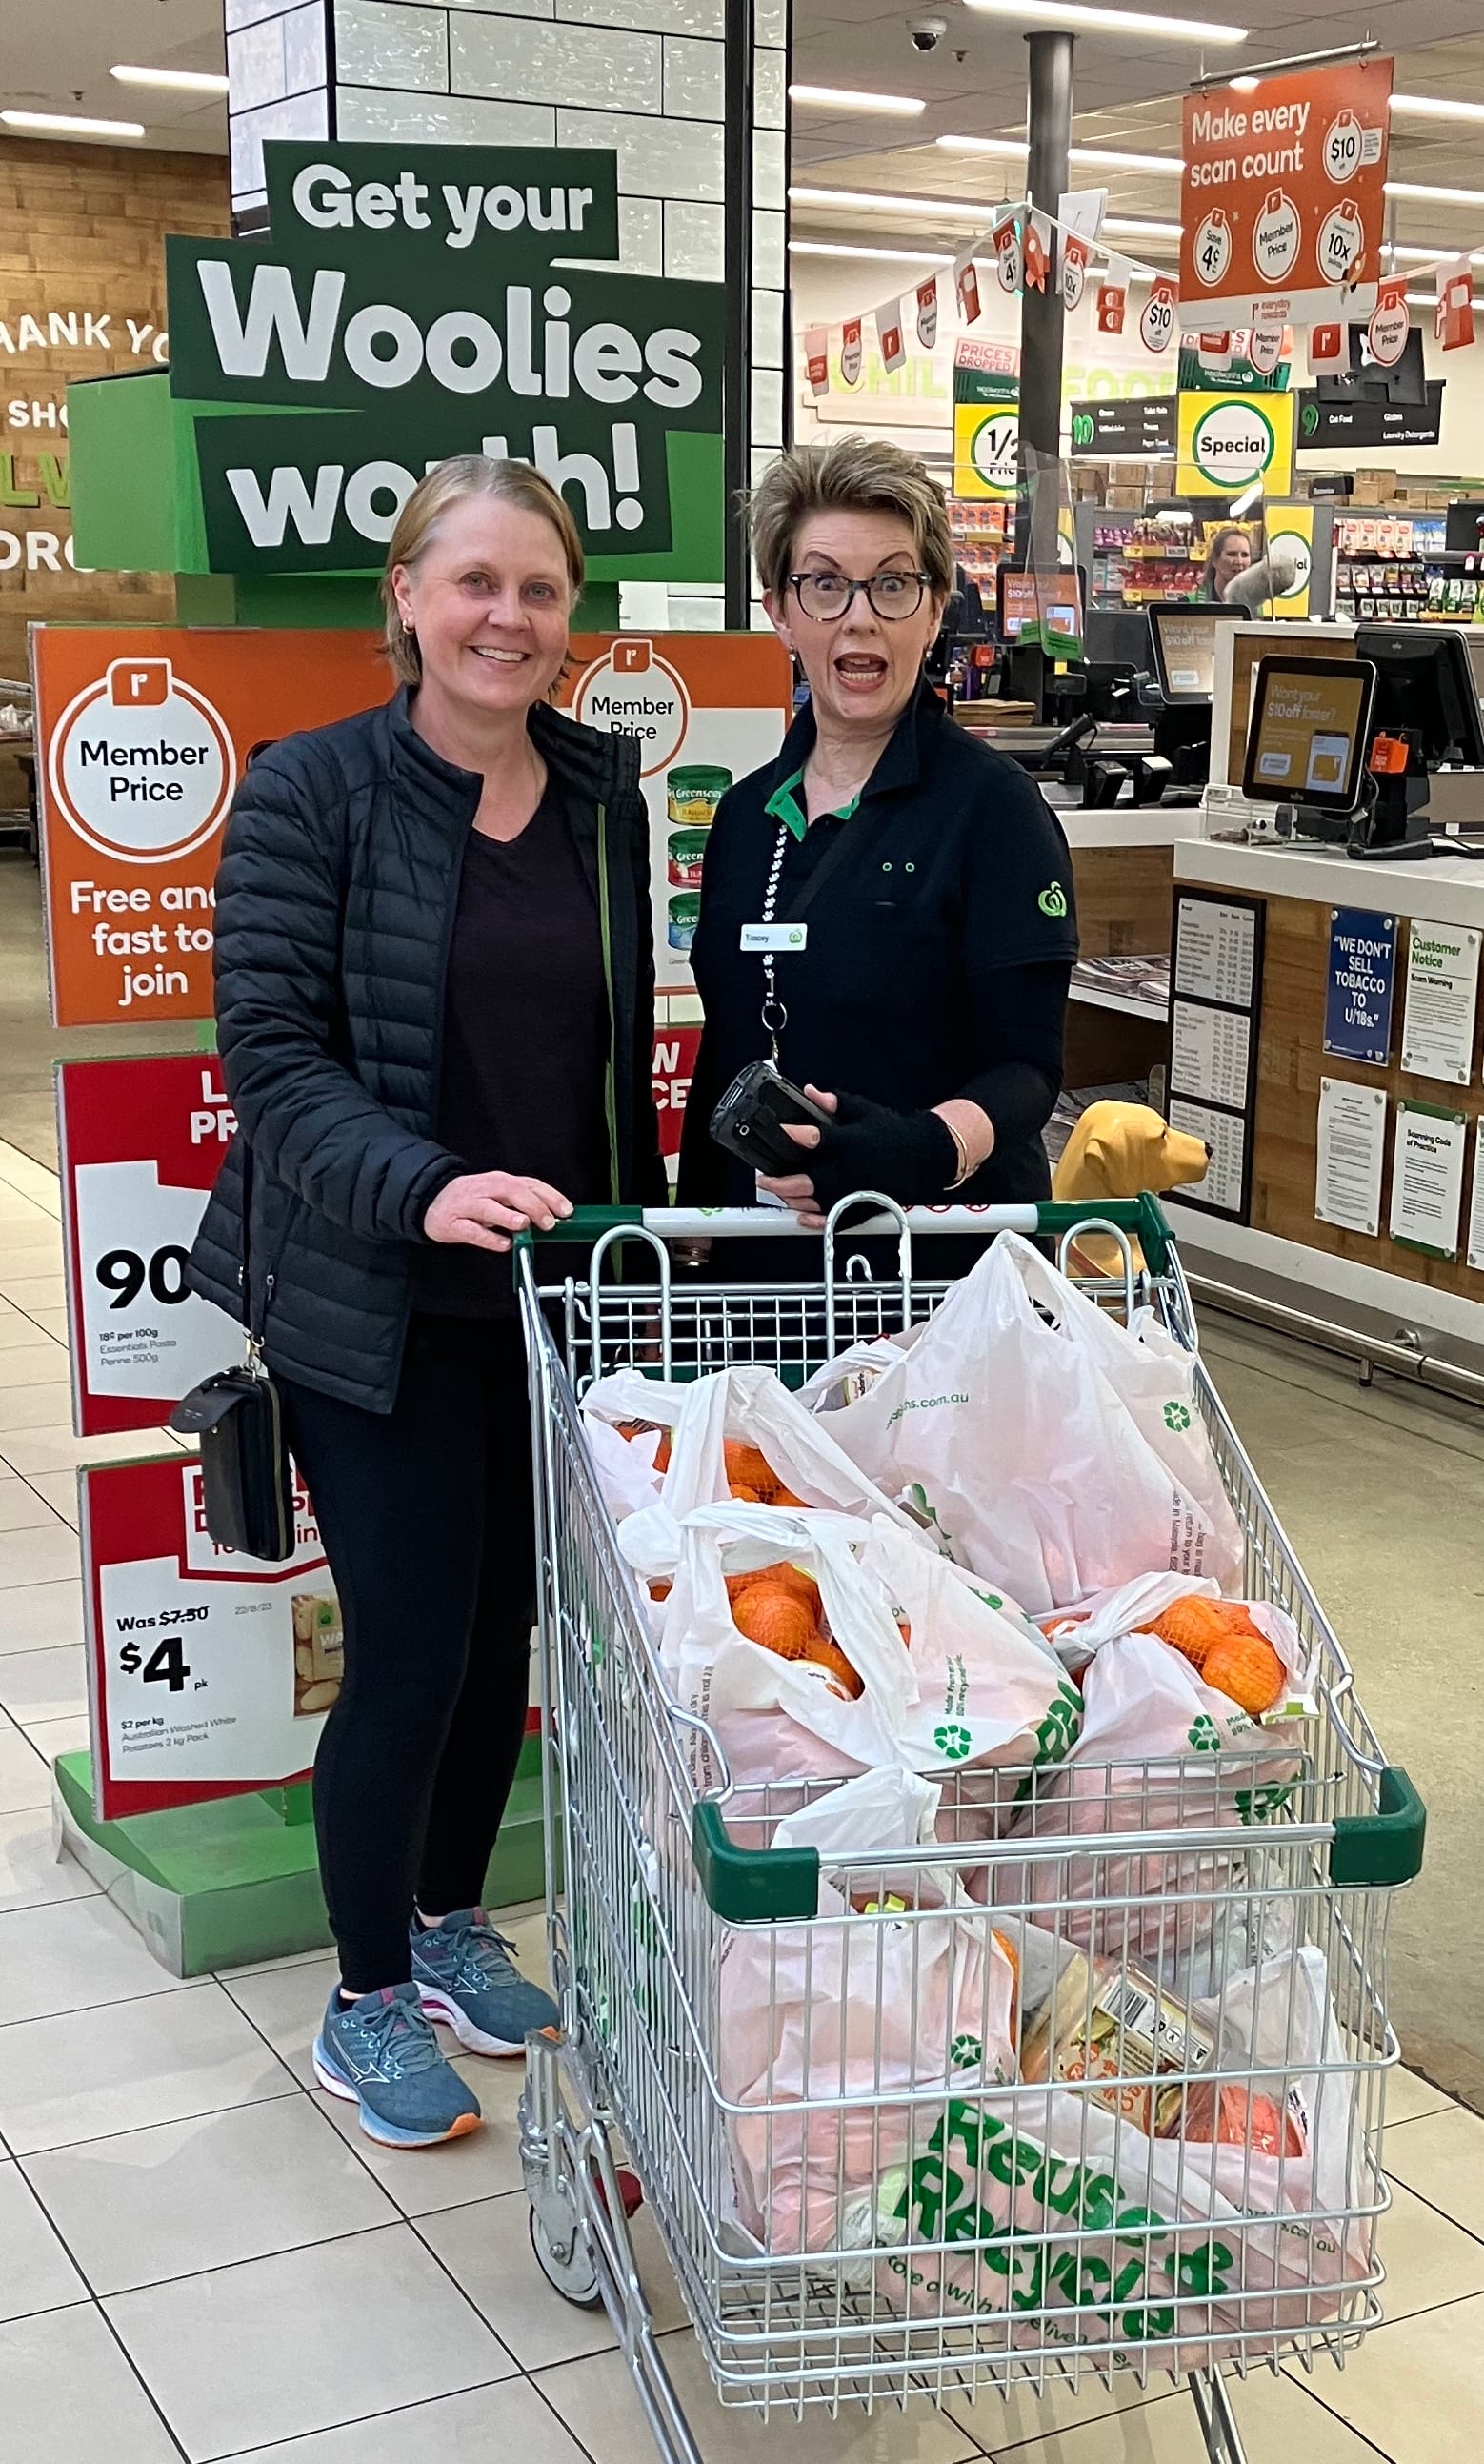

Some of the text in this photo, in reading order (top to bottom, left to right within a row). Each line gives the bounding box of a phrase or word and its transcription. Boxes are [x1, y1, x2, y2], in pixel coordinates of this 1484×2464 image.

[1192, 101, 1311, 144] Make every
[1331, 136, 1355, 162] $10
[1191, 140, 1305, 188] scan count
[292, 163, 592, 249] Get your
[1259, 222, 1293, 245] Member
[1267, 242, 1288, 258] Price
[1328, 233, 1351, 262] 10x
[1149, 304, 1171, 328] $10
[1375, 321, 1404, 333] Member
[196, 260, 702, 408] Woolies
[1255, 333, 1280, 343] Member
[1382, 334, 1398, 346] Price
[960, 343, 1013, 362] PRICES
[958, 355, 1011, 374] DROPPED
[1302, 404, 1318, 437] 9
[1201, 436, 1266, 456] Special
[226, 423, 645, 548] woh!
[1271, 685, 1321, 703] Want your
[592, 697, 674, 715] Member
[1267, 702, 1336, 721] $10 off faster?
[611, 721, 657, 739] Price
[80, 740, 209, 766] Member
[110, 776, 184, 802] Price
[70, 880, 151, 914] Free
[92, 922, 214, 955] fast to
[1357, 939, 1392, 959] DON'T
[1412, 937, 1461, 957] Customer
[1349, 955, 1374, 975] SELL
[1411, 950, 1444, 969] Notice
[118, 964, 188, 1007] join
[1335, 970, 1386, 994] TOBACCO
[1352, 991, 1367, 1008] TO
[1345, 1007, 1380, 1028] U/18s."
[95, 1244, 192, 1309] 90
[117, 1333, 133, 1342] per
[135, 1328, 159, 1339] 100g
[100, 1340, 177, 1354] Essentials Pasta
[100, 1352, 159, 1366] Penne 500g
[1186, 1513, 1194, 1537] return
[1184, 1539, 1193, 1547] to
[116, 1606, 211, 1632] Was $7.50
[119, 1636, 209, 1692] $4 pk
[120, 1717, 164, 1729] $2 per kg
[121, 1717, 237, 1742] Australian Washed White
[122, 1733, 209, 1754] Potatoes 2 kg Pack
[928, 2099, 1168, 2248] Reuse
[893, 2155, 1175, 2341] Recycle
